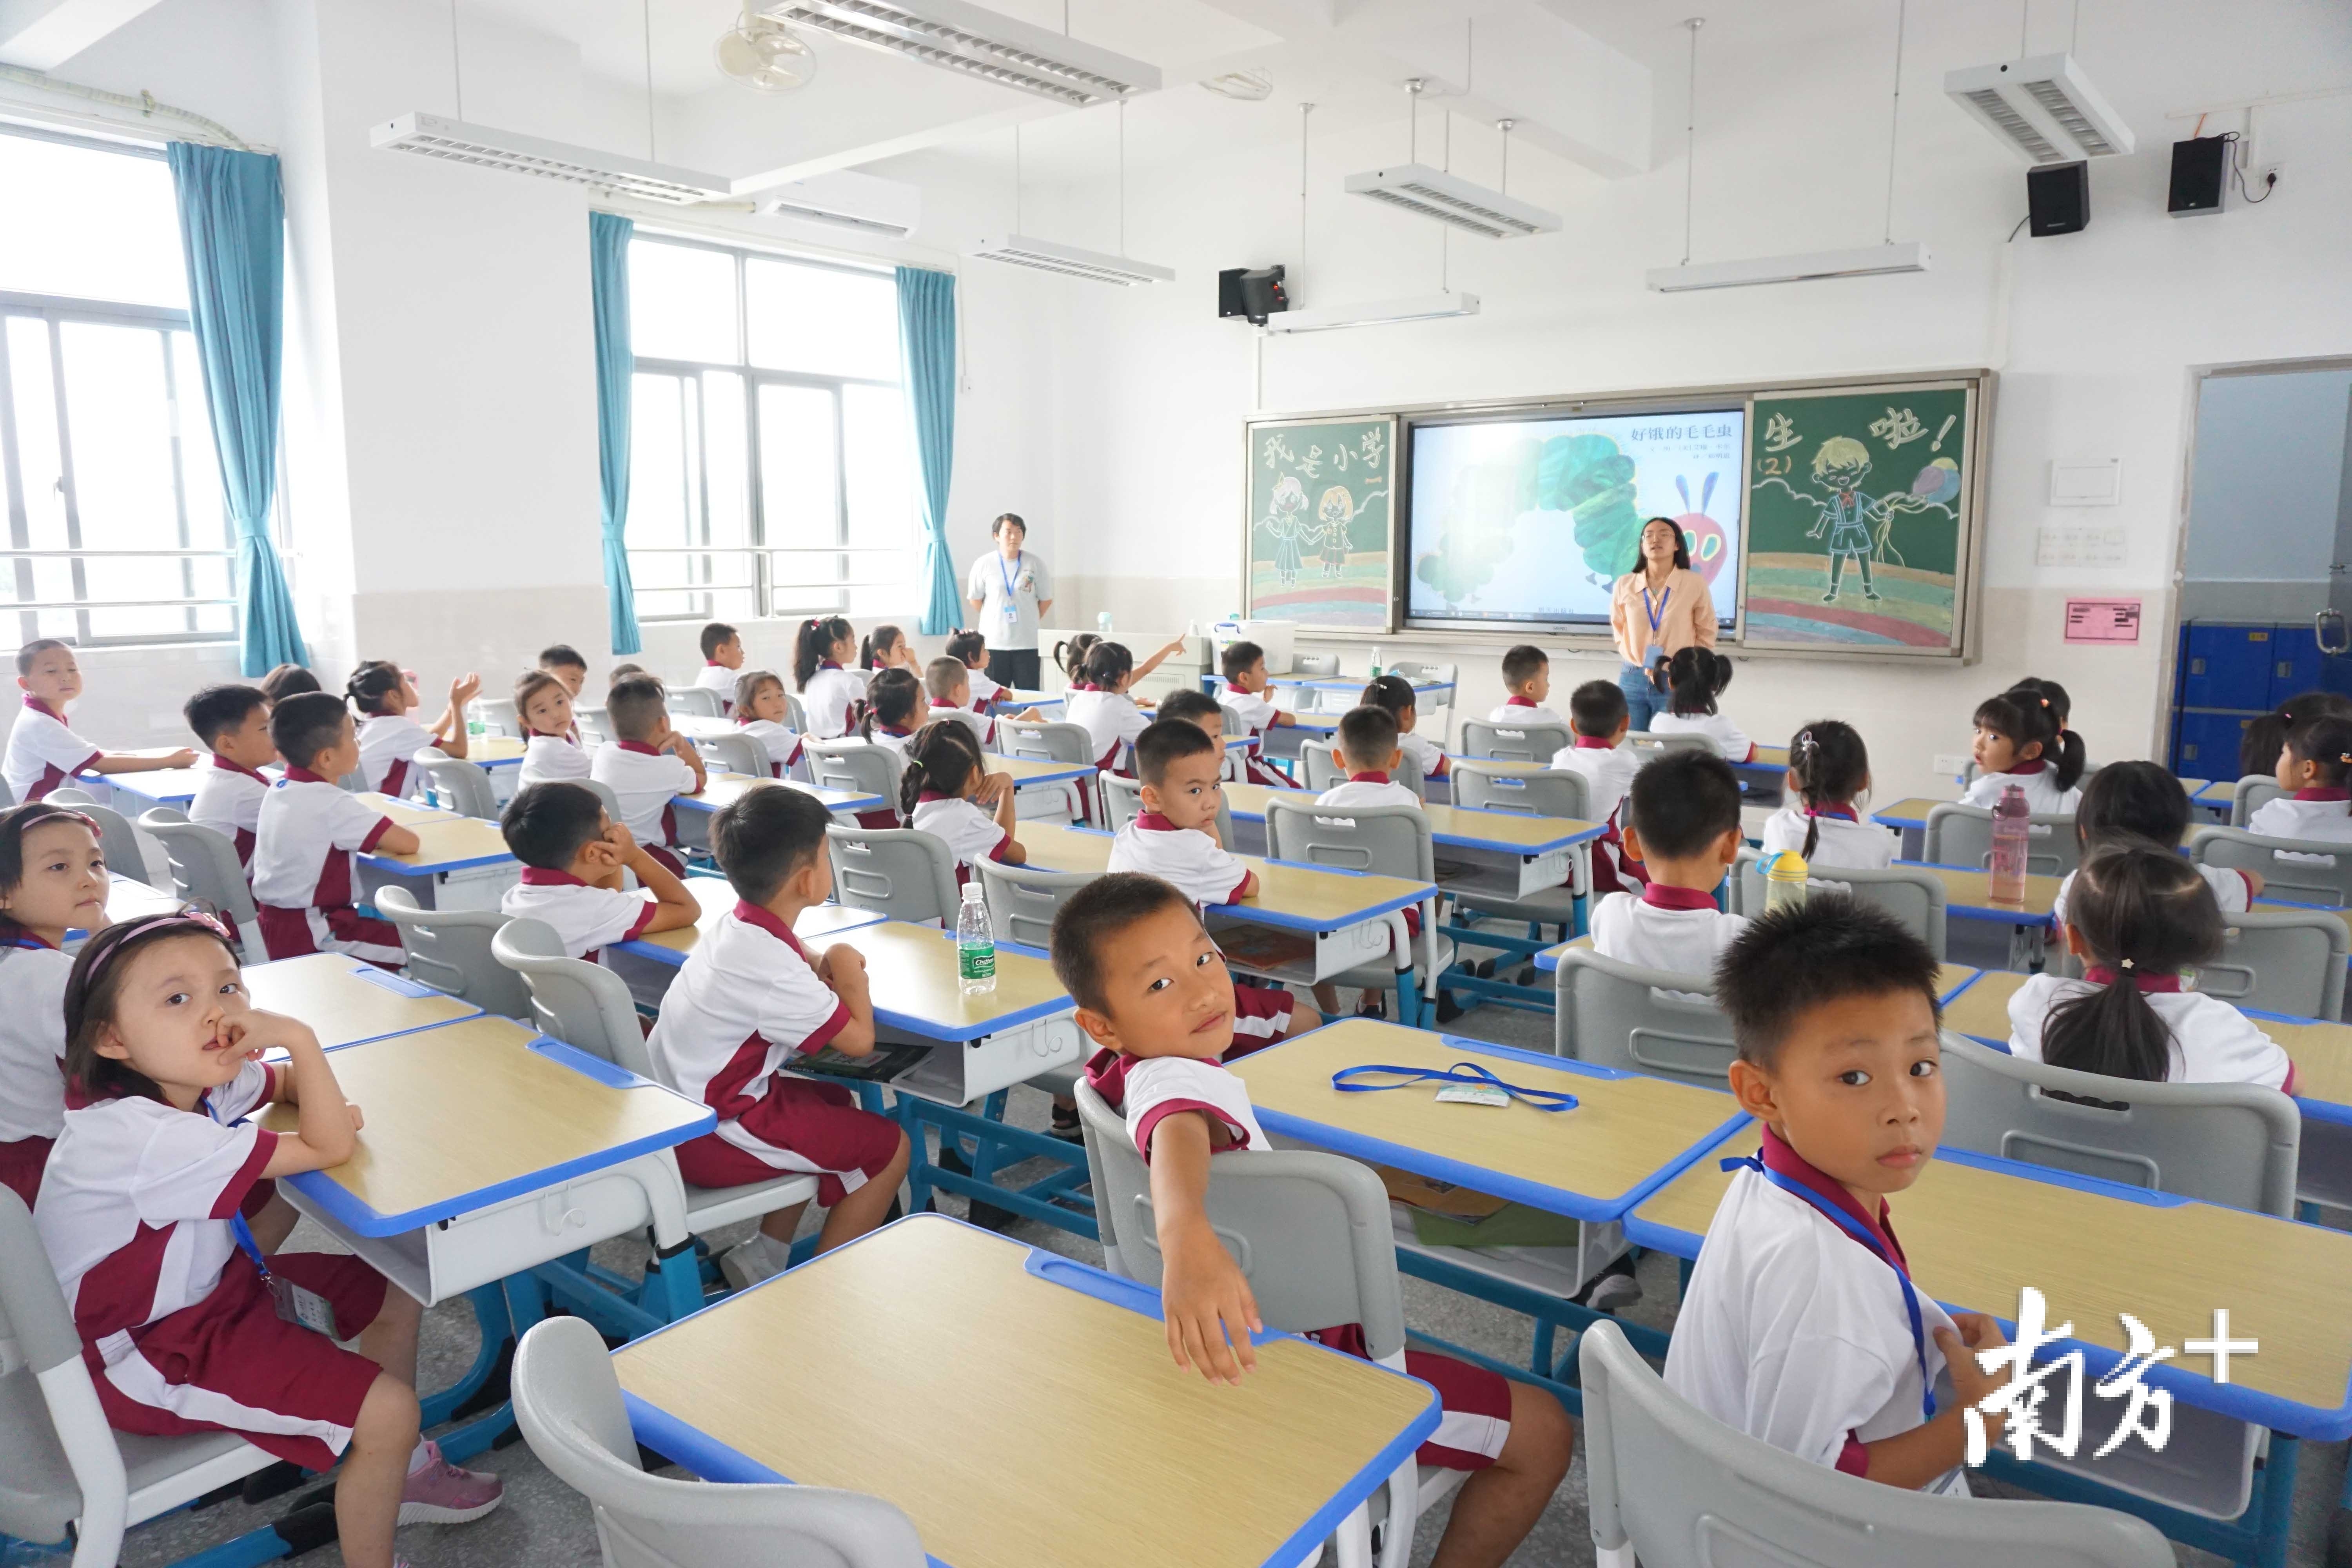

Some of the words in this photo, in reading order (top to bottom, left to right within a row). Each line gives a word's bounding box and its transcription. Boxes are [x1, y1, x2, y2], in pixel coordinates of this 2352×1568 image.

[1263, 426, 1386, 478] 我是小学
[1631, 424, 1733, 441] 好饿的毛毛虫
[1765, 412, 1803, 452] 生
